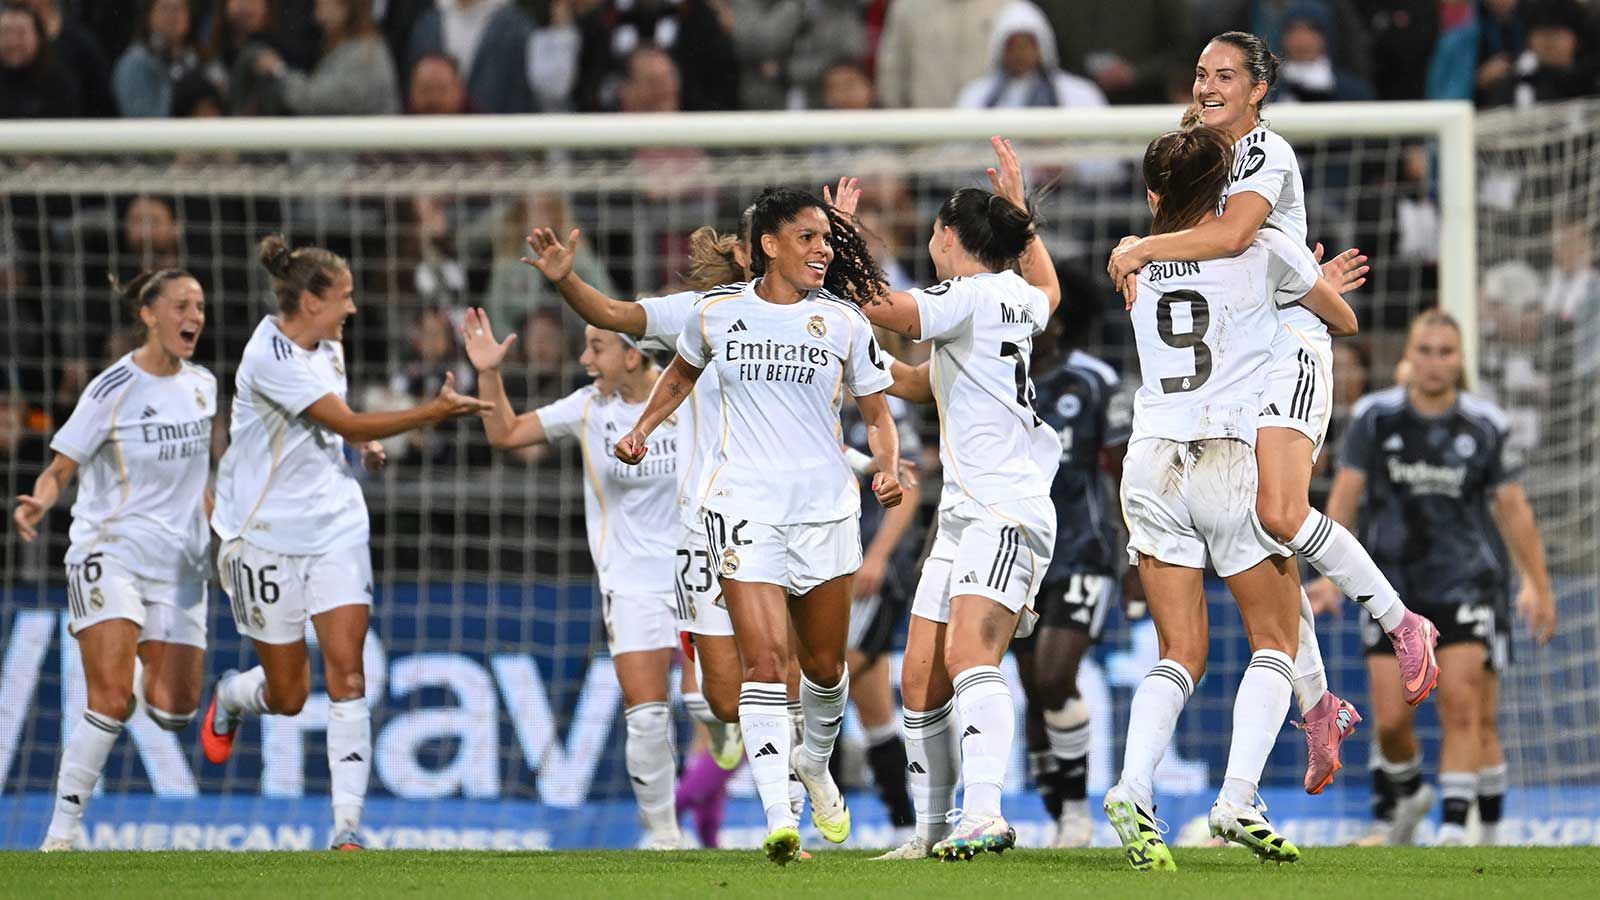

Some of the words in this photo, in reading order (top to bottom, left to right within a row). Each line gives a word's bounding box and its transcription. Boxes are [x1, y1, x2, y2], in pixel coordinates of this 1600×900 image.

[726, 340, 828, 366] Emirates
[1156, 289, 1212, 394] 9
[740, 364, 761, 381] FLY
[766, 364, 815, 384] BETTER
[83, 552, 103, 584] 6
[242, 563, 280, 604] 16
[676, 549, 713, 592] 23
[328, 825, 549, 850] XPRESS
